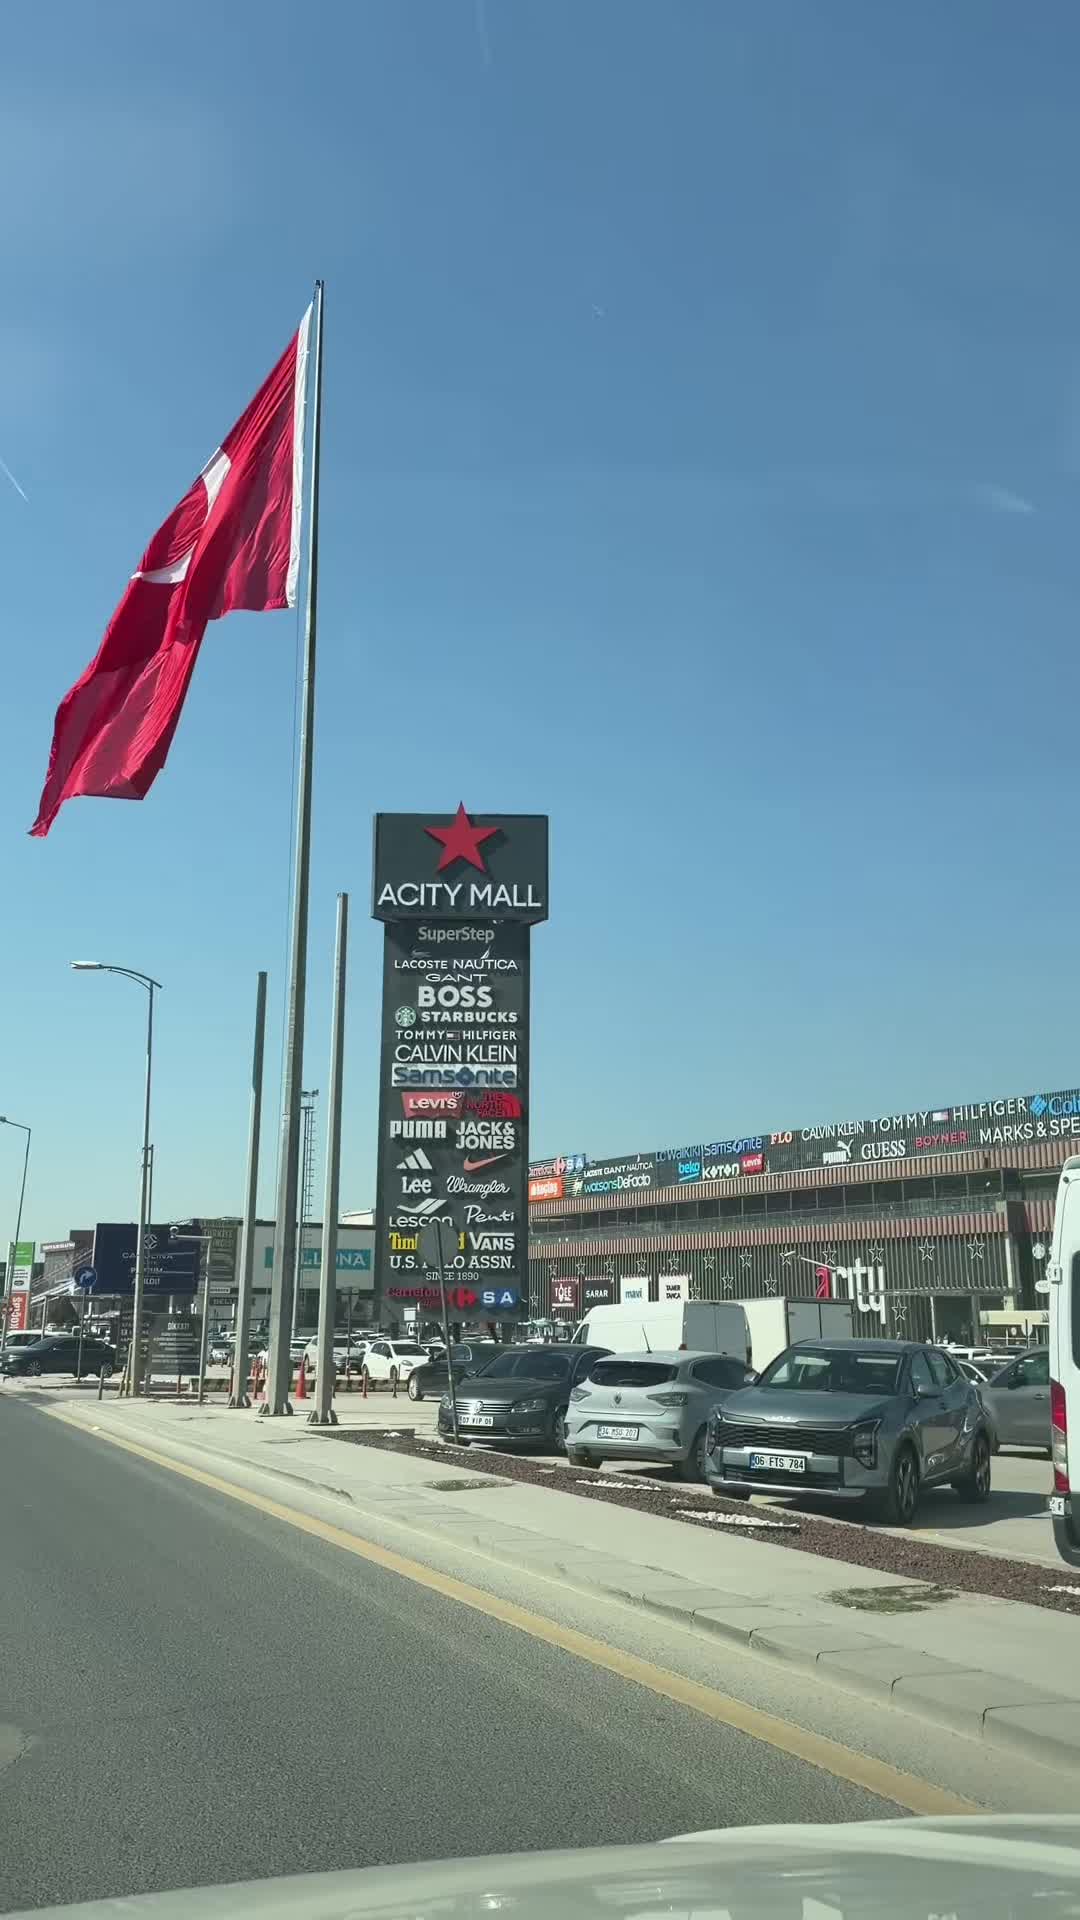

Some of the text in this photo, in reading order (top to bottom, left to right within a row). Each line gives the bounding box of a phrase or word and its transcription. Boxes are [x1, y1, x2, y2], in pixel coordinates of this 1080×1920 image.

[378, 884, 541, 907] ACITY MALL
[418, 926, 495, 943] SuperStep
[394, 959, 518, 970] LACOSTE NAUTICA
[425, 973, 488, 982] GANT
[418, 985, 493, 1008] BOSS
[421, 1011, 518, 1022] STARBUCKS
[395, 1030, 517, 1040] TOMMY HILFIGER
[395, 1044, 517, 1062] CALVIN KLEIN
[394, 1066, 516, 1087] Samsonite
[871, 1097, 1028, 1133] TOMMY HILFIGER
[389, 1120, 447, 1138] PUMA
[801, 1120, 865, 1141] CALVIN KLEIN
[980, 1122, 1034, 1144] MARKS
[1036, 1121, 1047, 1138] &
[456, 1135, 515, 1149] JONES
[704, 1136, 763, 1156] Samsonite
[770, 1132, 793, 1145] FLO
[915, 1131, 968, 1148] BOYNER
[861, 1140, 906, 1160] GUESS
[604, 1165, 627, 1174] GANT
[626, 1161, 653, 1171] NAUTICA
[678, 1161, 701, 1174] beko
[402, 1176, 432, 1193] Lee
[446, 1176, 510, 1199] Wrangler
[584, 1173, 651, 1193] watsons DeFacto
[464, 1205, 515, 1224] Penti
[469, 1232, 515, 1250] VANS
[389, 1256, 418, 1269] U.S.
[468, 1256, 516, 1269] ASSN.
[458, 1272, 479, 1280] 1890
[586, 1290, 609, 1299] SARAR
[625, 1288, 643, 1299] mavi
[755, 1455, 804, 1470] 06 FTS 784
